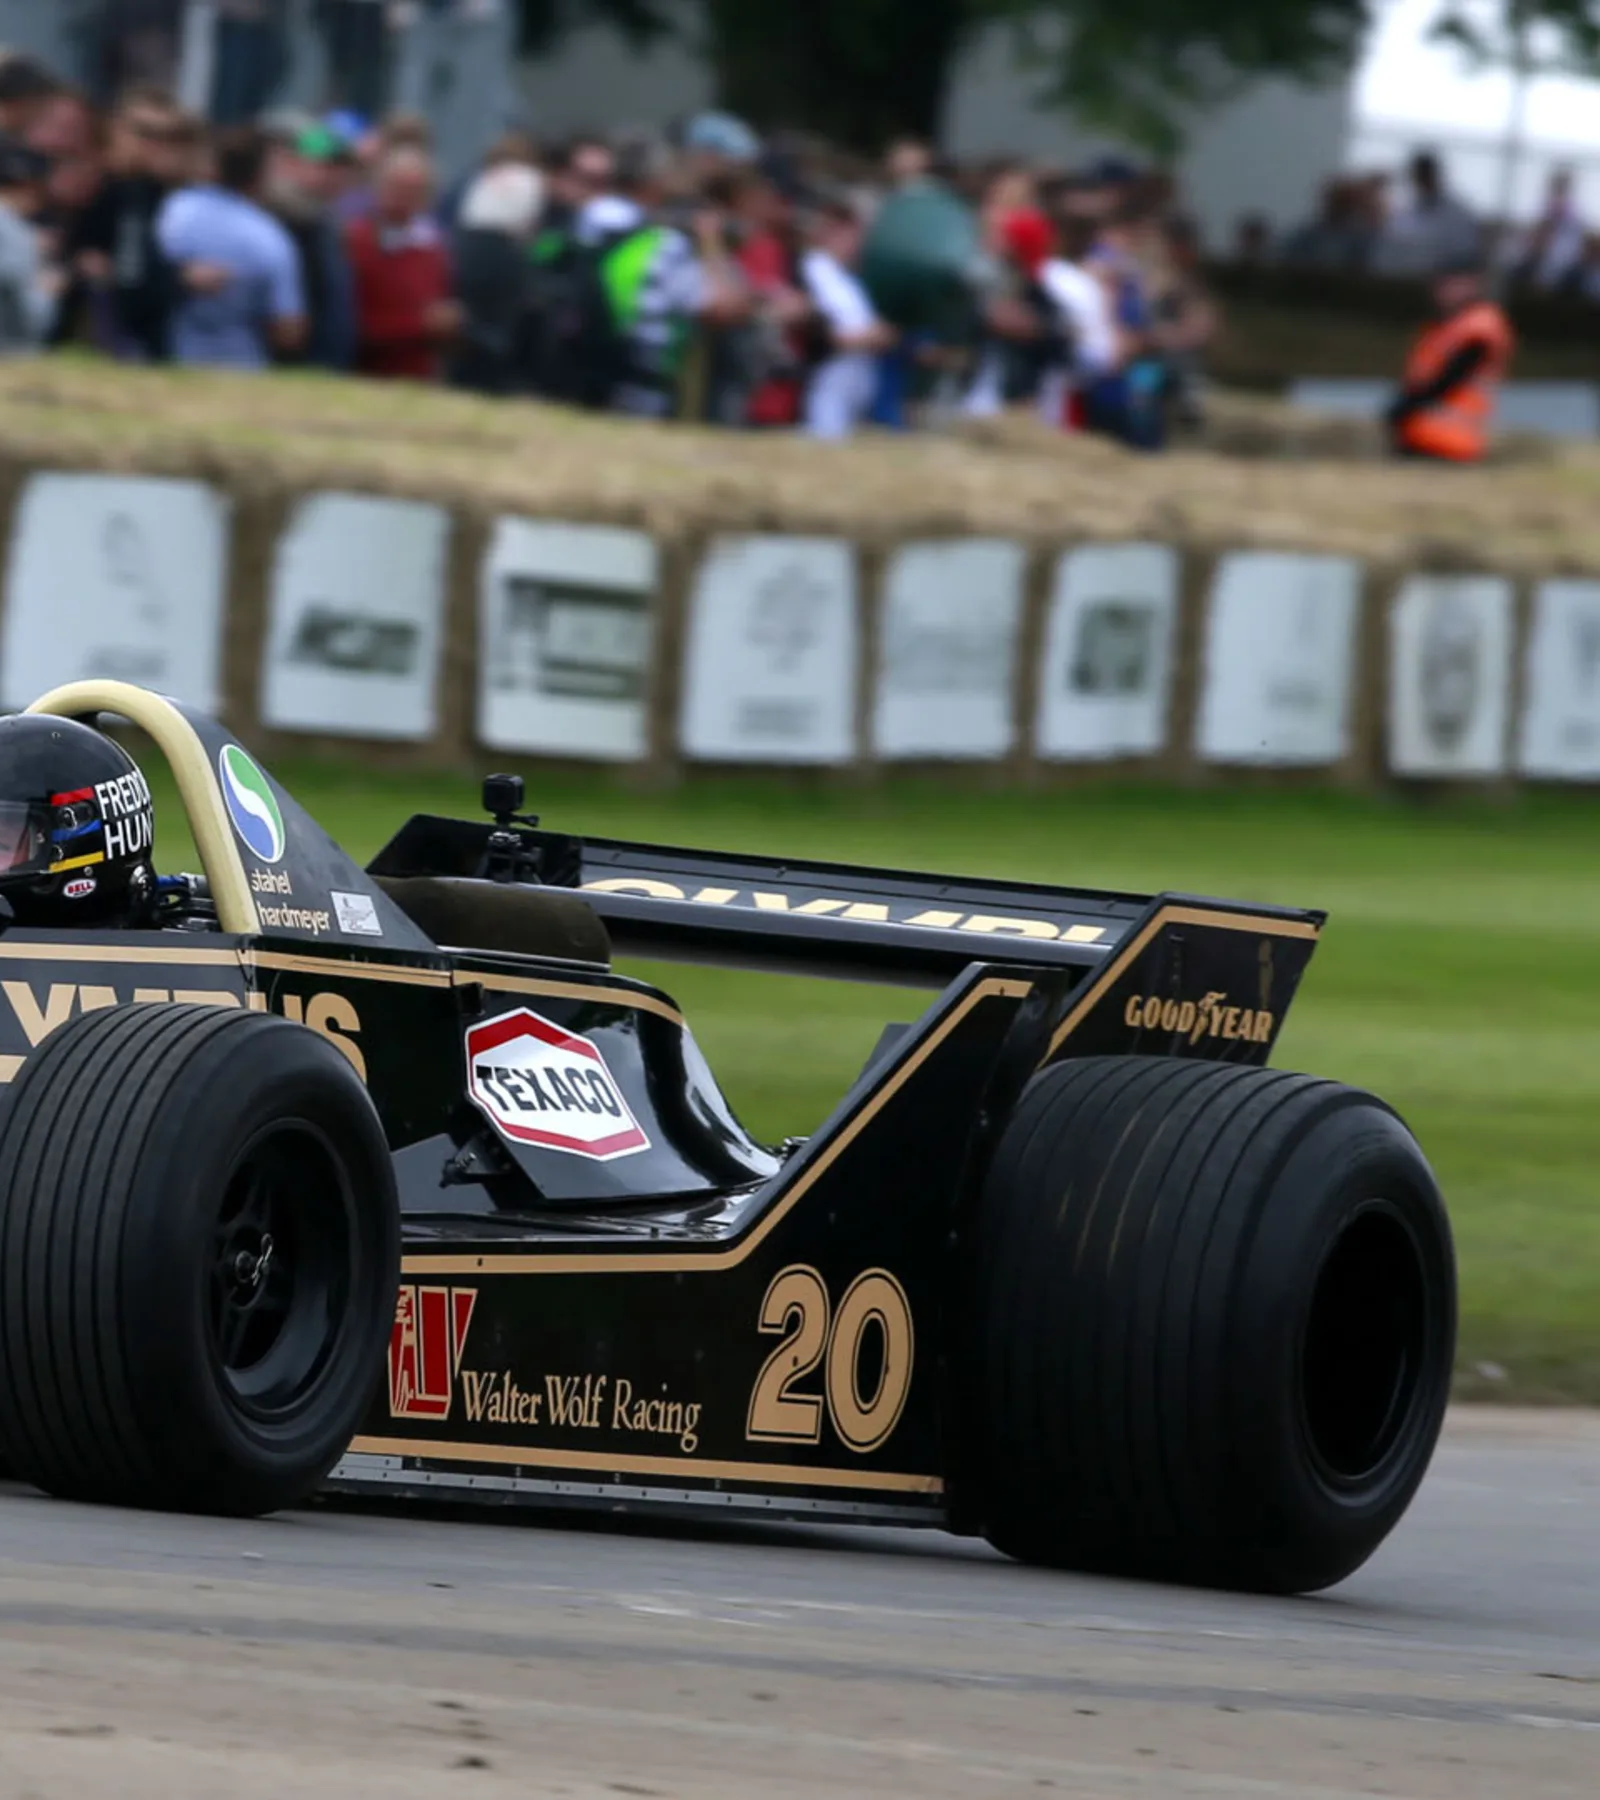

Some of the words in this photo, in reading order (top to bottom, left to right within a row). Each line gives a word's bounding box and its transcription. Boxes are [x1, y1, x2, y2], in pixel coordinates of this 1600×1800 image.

[104, 805, 153, 860] HUN
[68, 882, 93, 893] BELL
[251, 868, 292, 894] stahel
[257, 901, 330, 935] hardmeyer
[1124, 991, 1273, 1046] GOODYEAR
[475, 1065, 622, 1118] TEXACO
[745, 1263, 915, 1454] 20
[461, 1369, 542, 1425] Walter
[544, 1373, 607, 1428] Wolf
[611, 1379, 702, 1453] Racing
